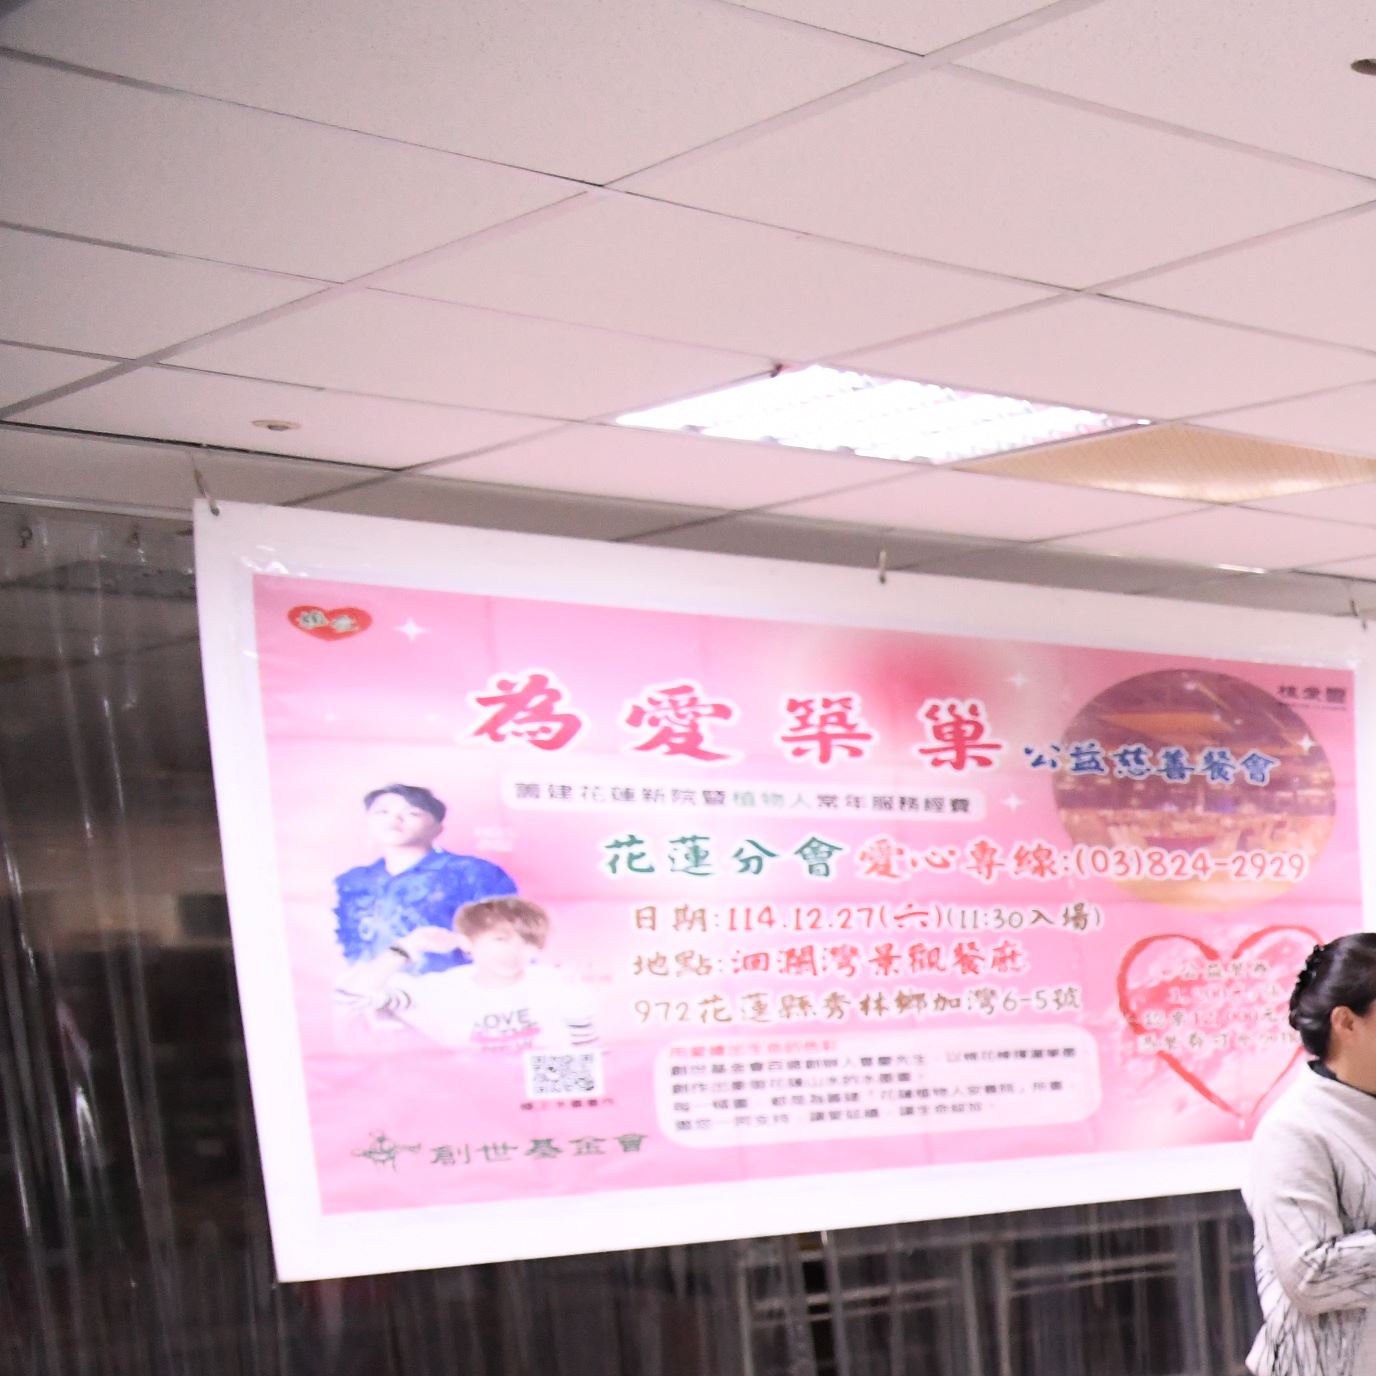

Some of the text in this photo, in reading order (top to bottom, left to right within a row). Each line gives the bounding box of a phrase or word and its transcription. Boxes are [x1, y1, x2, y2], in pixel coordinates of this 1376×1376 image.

[470, 672, 1282, 786] 為愛築巢 公益慈善餐會
[430, 1130, 652, 1166] 創世基金會
